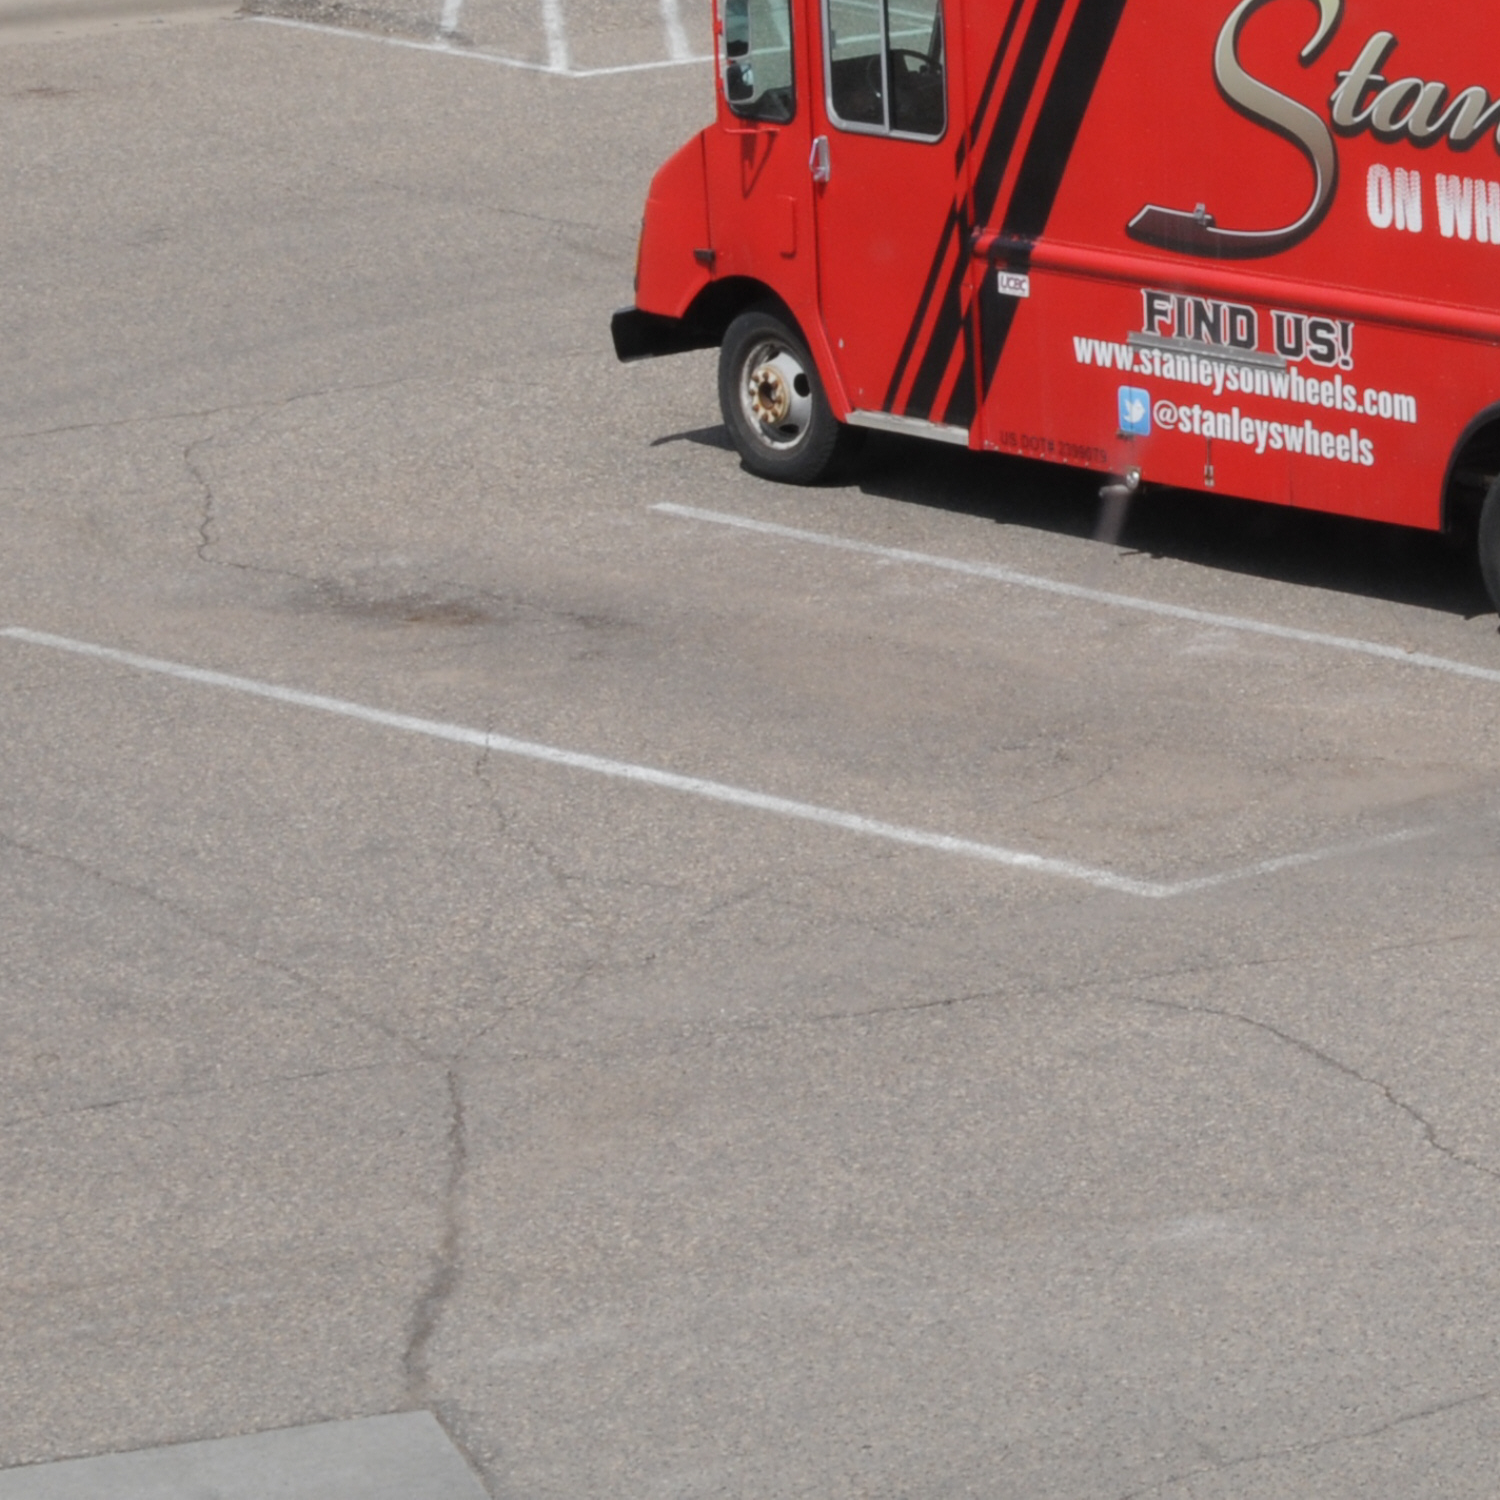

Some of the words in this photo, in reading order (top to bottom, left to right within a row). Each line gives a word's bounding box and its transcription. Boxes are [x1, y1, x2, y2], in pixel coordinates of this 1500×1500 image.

[1366, 163, 1422, 233] ON
[1140, 287, 1259, 351] FIND
[1270, 309, 1355, 370] US!
[1073, 336, 1418, 424] www.stanleysonwheels.com
[1153, 398, 1375, 467] @stanleyswheels
